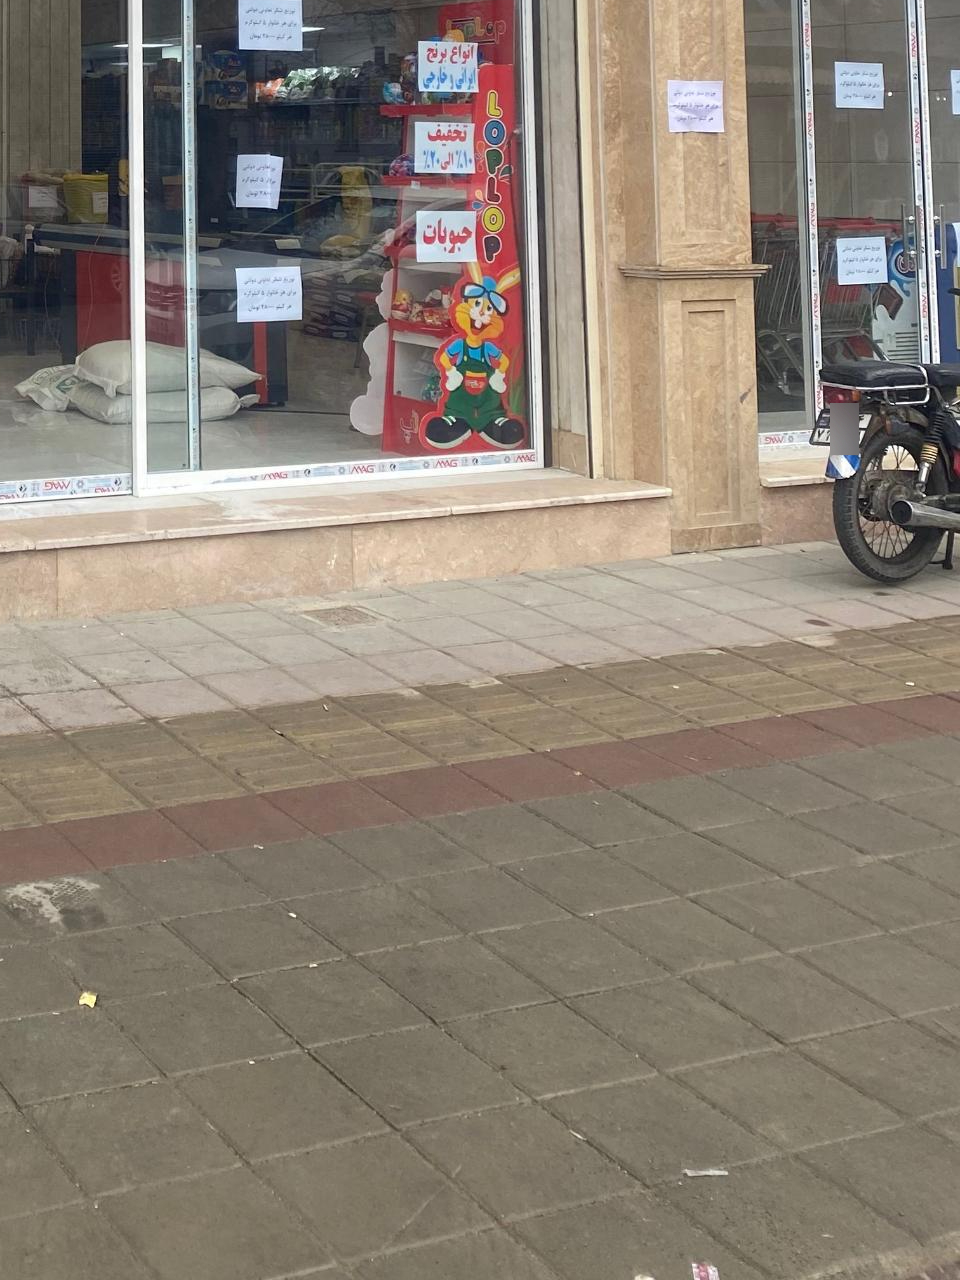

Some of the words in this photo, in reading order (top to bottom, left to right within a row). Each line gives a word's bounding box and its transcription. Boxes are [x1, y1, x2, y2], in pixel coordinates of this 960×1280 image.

[426, 43, 447, 64] برنج
[450, 44, 474, 64] انواع
[423, 66, 447, 90] خارجی
[427, 124, 468, 146] تخفیف
[441, 152, 454, 170] الی
[483, 89, 507, 263] LOPLOP
[423, 219, 473, 254] حبوبات
[351, 464, 375, 474] MAG
[435, 459, 458, 468] MAG
